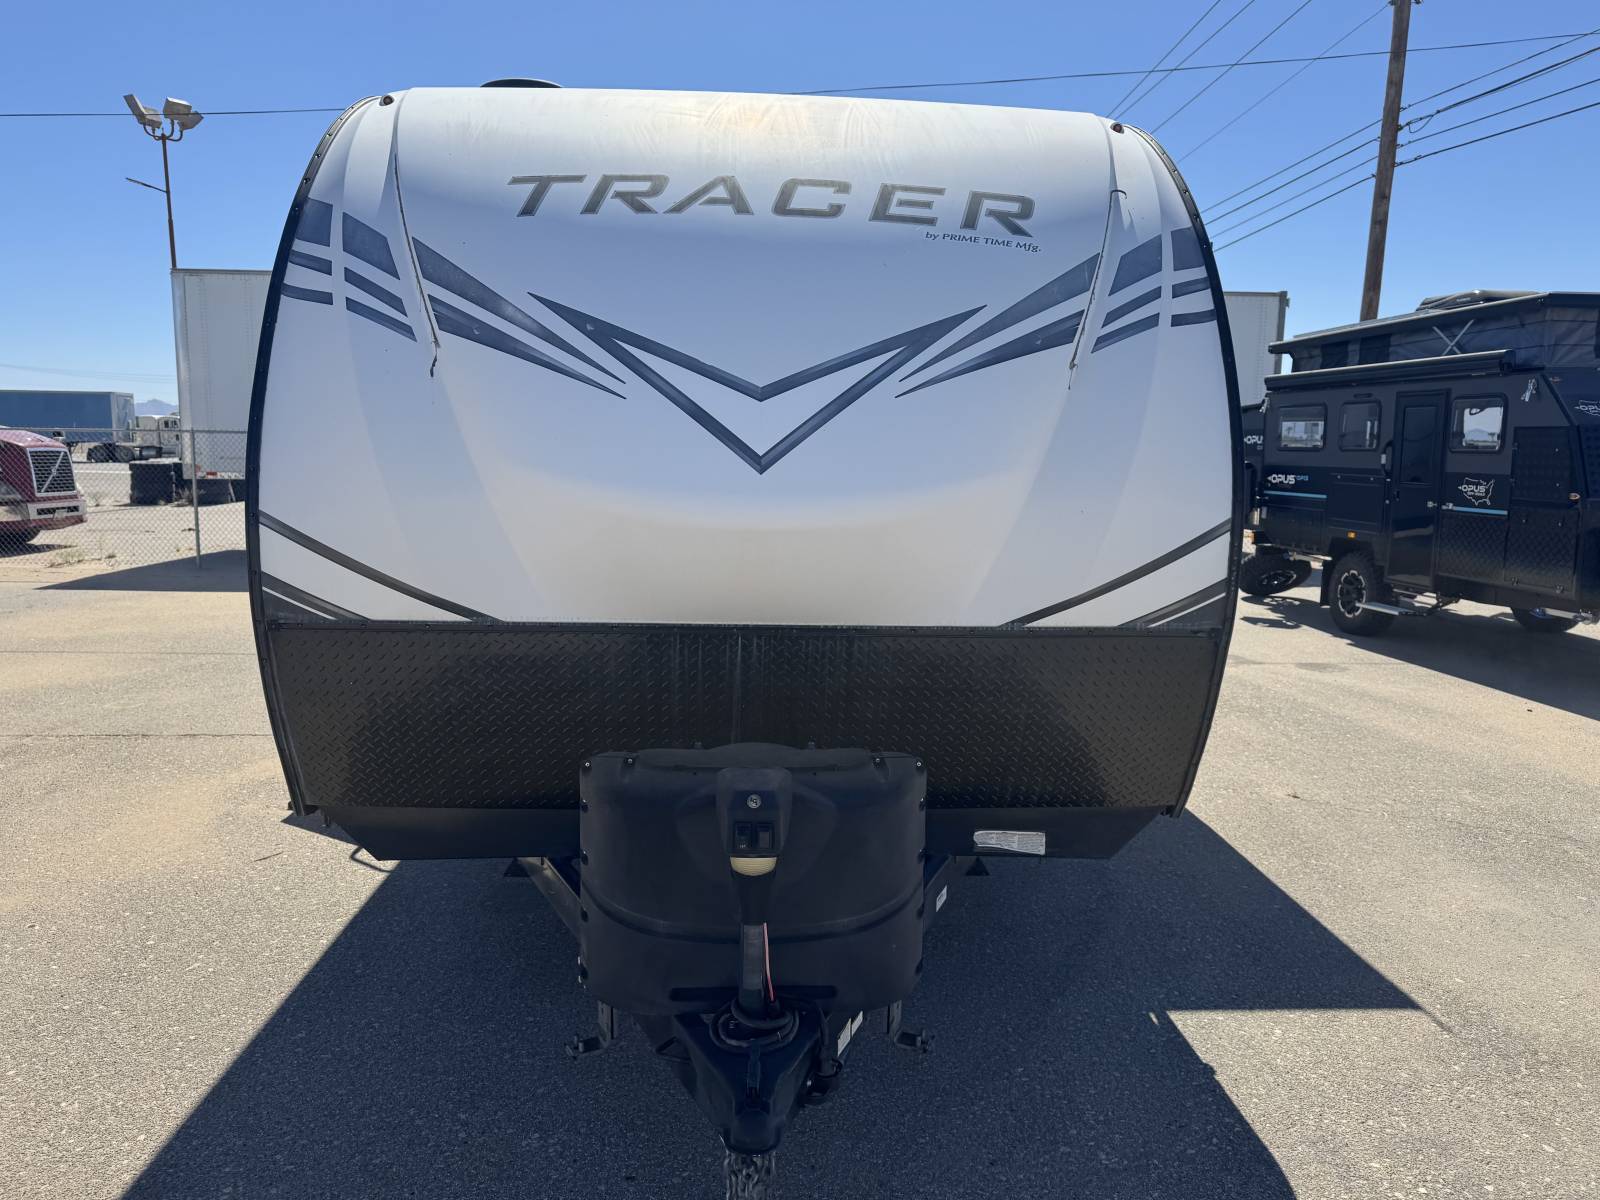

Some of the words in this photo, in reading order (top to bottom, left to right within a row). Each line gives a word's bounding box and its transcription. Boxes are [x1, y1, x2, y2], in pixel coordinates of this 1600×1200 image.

[508, 173, 1035, 238] TRACER
[925, 231, 940, 241] by
[942, 233, 981, 244] PRIME
[983, 237, 1013, 248] TIME
[1015, 241, 1043, 253] Mfg.
[1579, 405, 1600, 413] OPU
[1245, 435, 1263, 445] OPU
[1270, 474, 1296, 485] OPUS
[1461, 484, 1486, 493] OPUS
